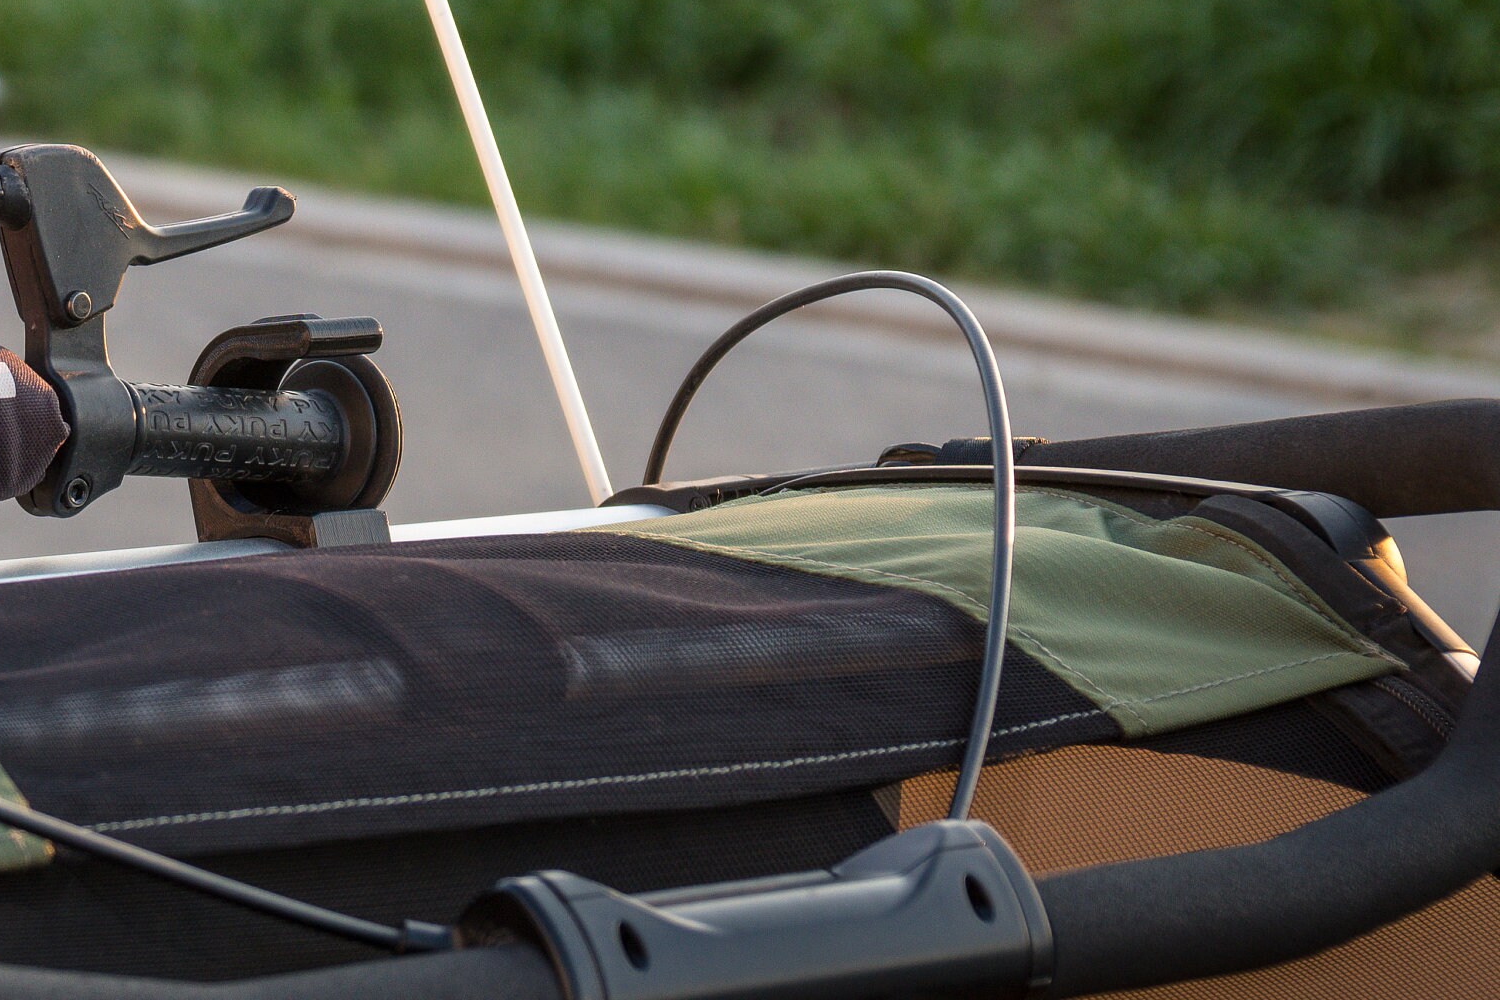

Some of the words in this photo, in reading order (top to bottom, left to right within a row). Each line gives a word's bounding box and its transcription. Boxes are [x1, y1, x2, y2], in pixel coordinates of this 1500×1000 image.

[201, 414, 288, 441] PUKY
[140, 440, 238, 464] PUKY
[244, 445, 337, 470] PUKY
